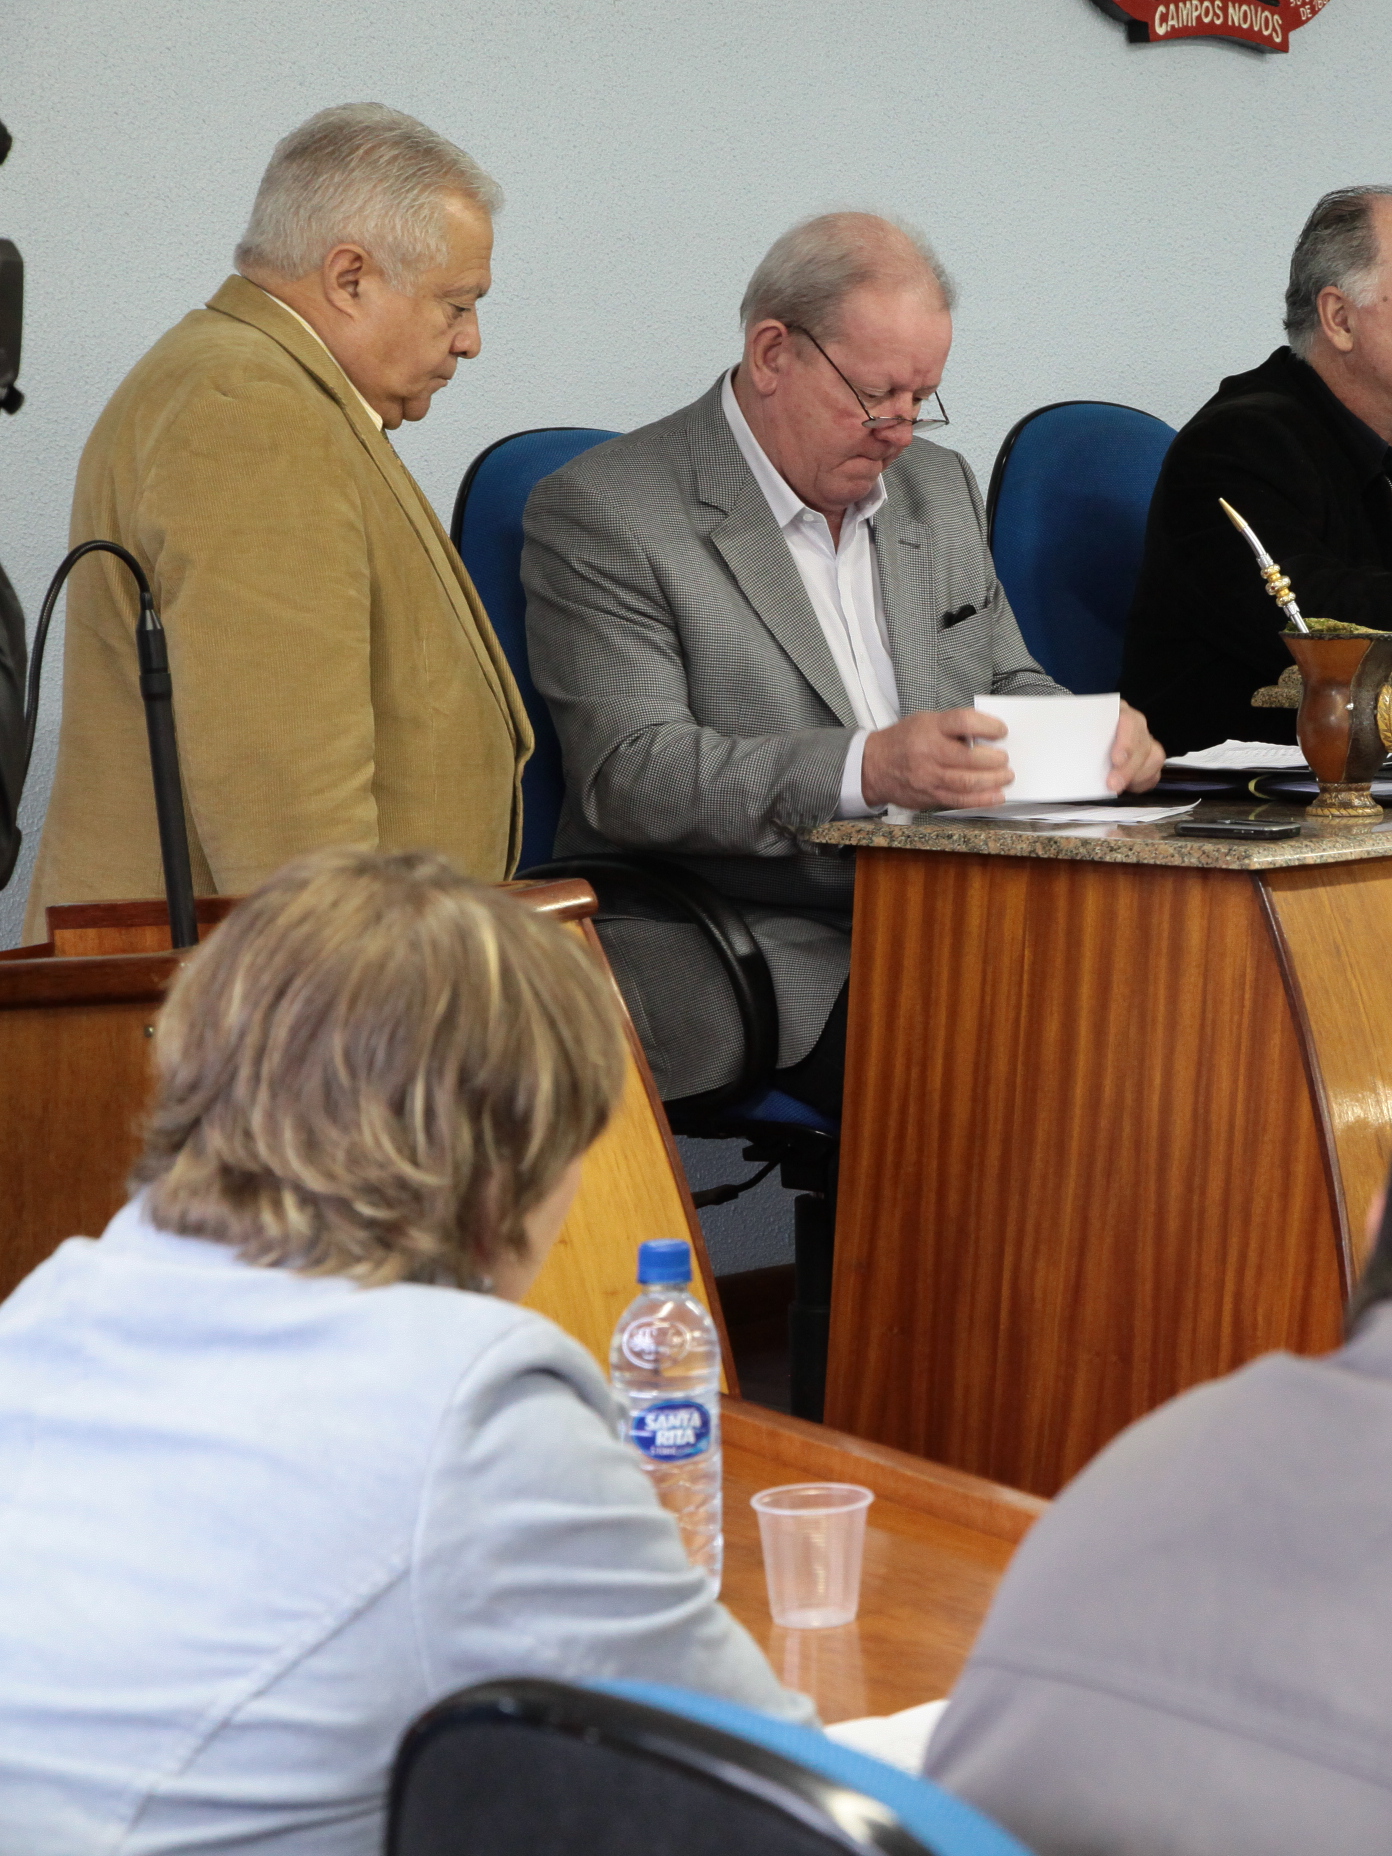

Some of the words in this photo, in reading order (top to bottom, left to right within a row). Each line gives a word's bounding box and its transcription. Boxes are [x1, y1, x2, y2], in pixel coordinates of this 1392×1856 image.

[1155, 0, 1224, 36] CAMPOS
[1228, 1, 1283, 43] NOVOS
[645, 1410, 701, 1430] SANTA
[655, 1427, 696, 1447] RITA
